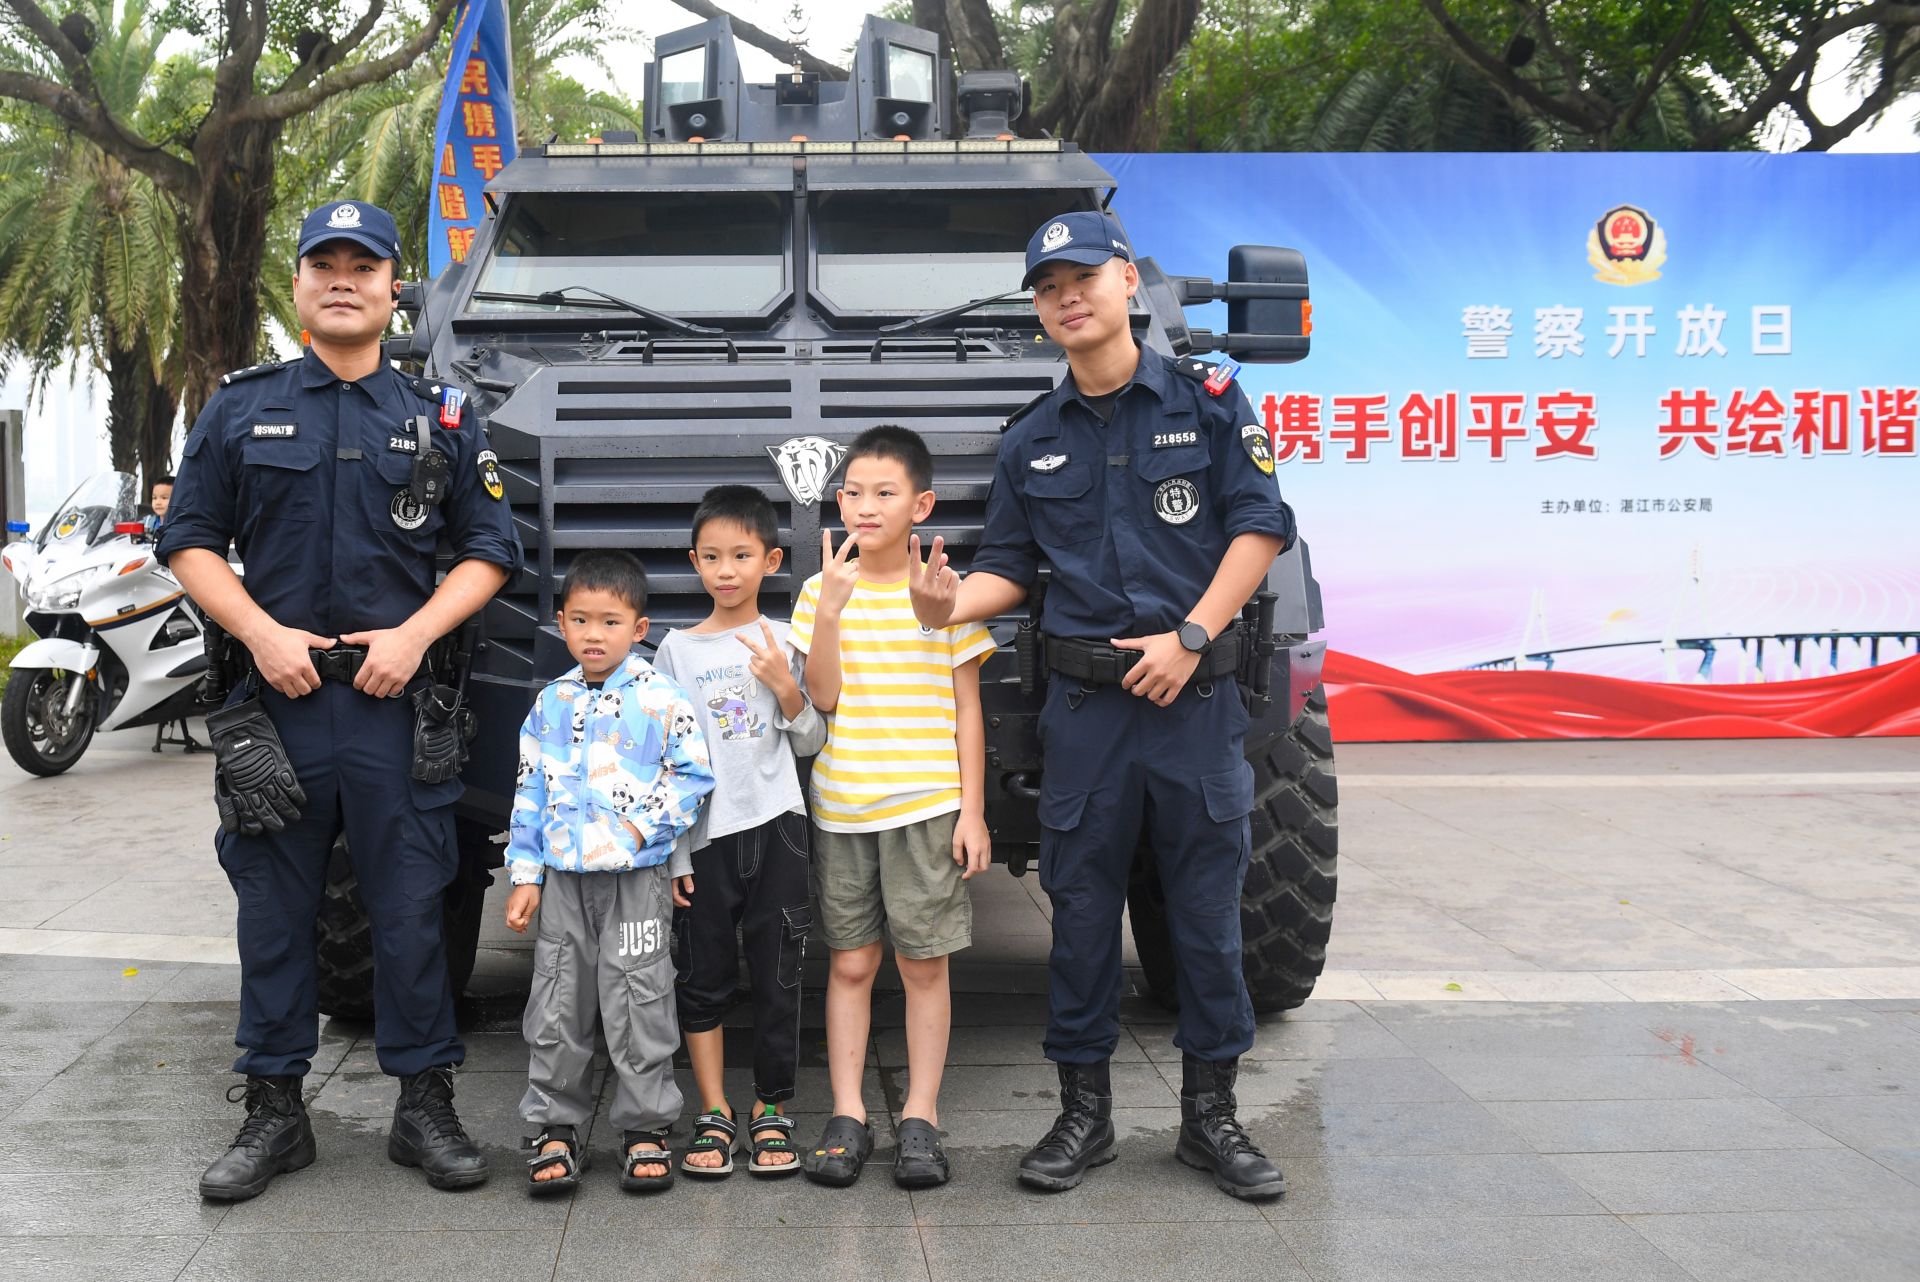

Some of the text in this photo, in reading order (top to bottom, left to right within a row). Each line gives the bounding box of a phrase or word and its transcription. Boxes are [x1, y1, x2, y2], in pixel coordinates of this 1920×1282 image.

[1461, 304, 1792, 359] 警察开放日
[1154, 432, 1197, 445] 218558
[1260, 388, 1918, 460] 携手创平安 共绘和谐
